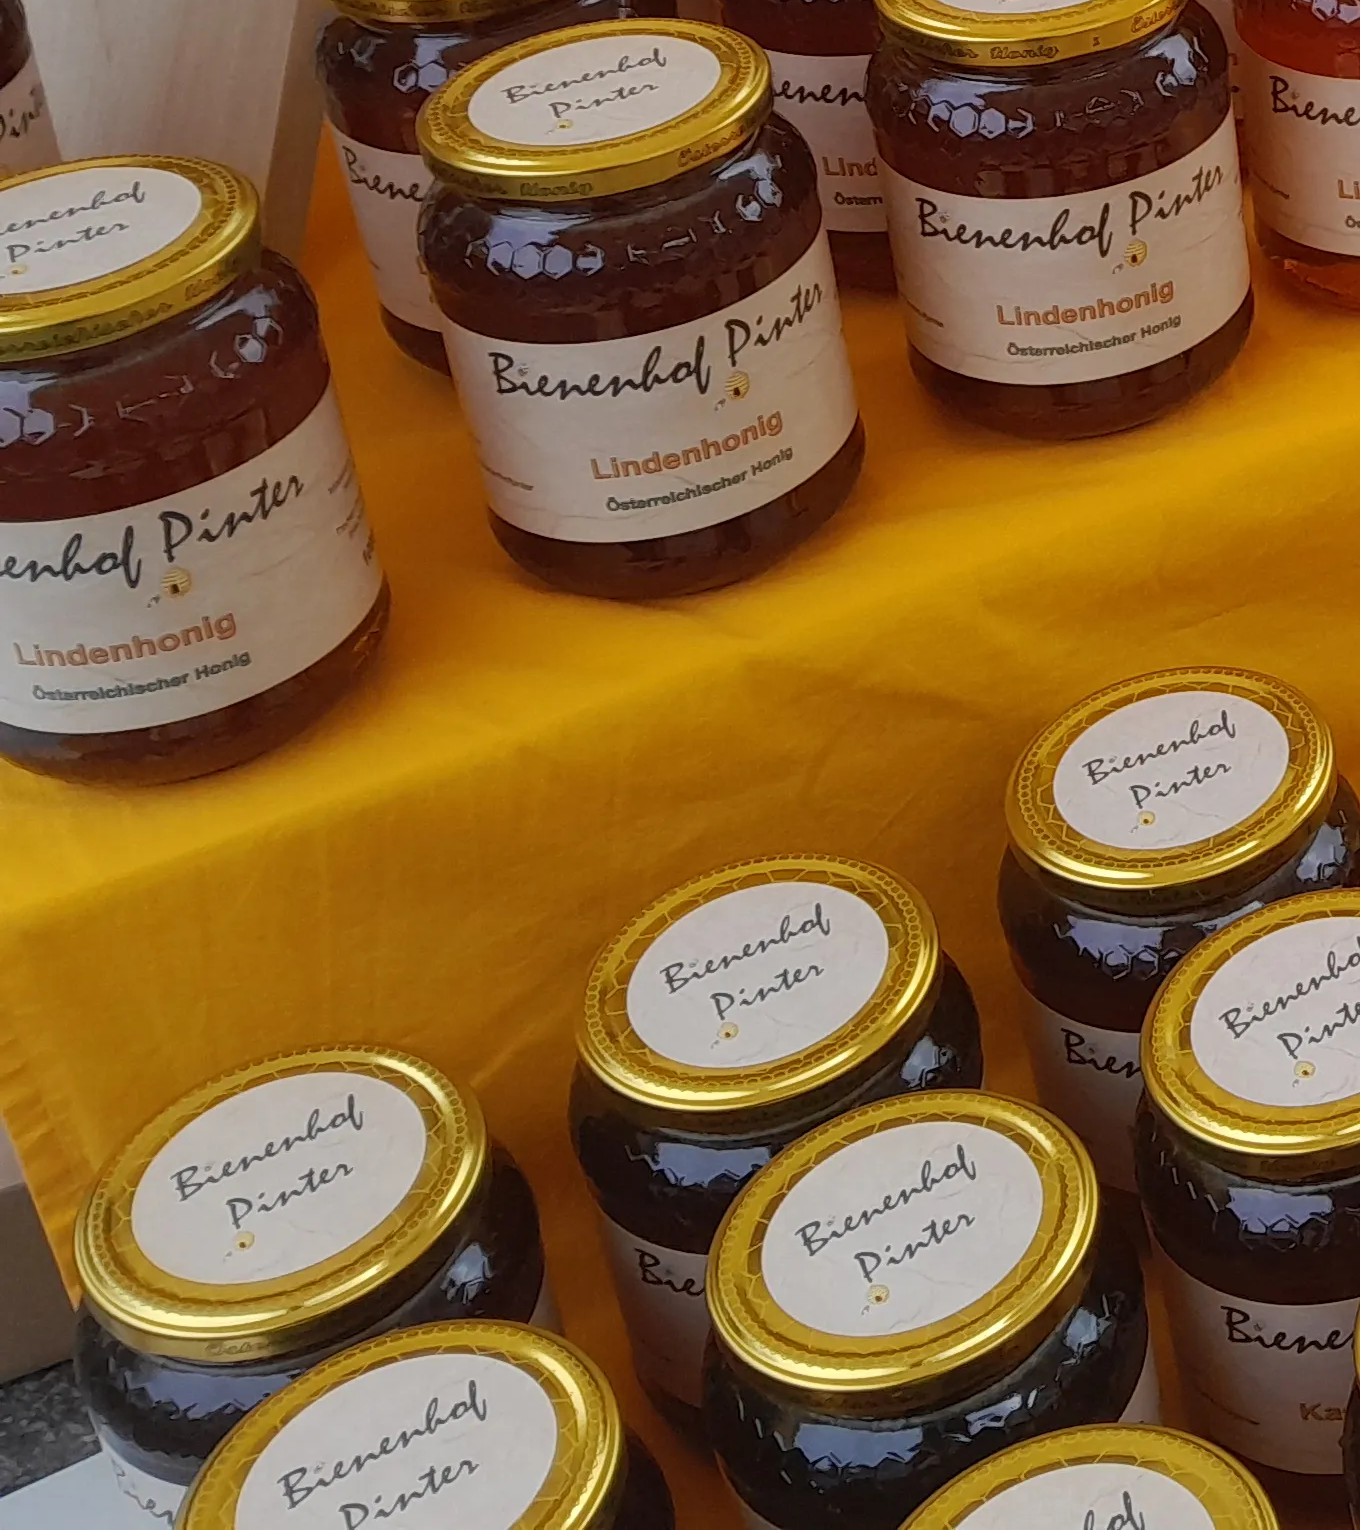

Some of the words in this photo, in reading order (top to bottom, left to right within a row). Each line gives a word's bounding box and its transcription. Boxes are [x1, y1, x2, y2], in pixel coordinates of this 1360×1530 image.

[500, 48, 668, 105] Bienenhof
[548, 82, 658, 119] Pinter
[6, 222, 129, 263] Pinter
[915, 197, 1112, 258] Bienenhof
[1129, 162, 1224, 236] Pinter
[996, 278, 1175, 327] Lindenhonig
[1006, 327, 1138, 358] Österreichischer
[1140, 313, 1183, 338] Honig
[488, 337, 712, 399] Bienenhof
[725, 281, 823, 368] Pinter
[591, 410, 783, 480] Lindenhonig
[606, 469, 748, 514] Österreichischer
[751, 444, 794, 477] Honig
[159, 474, 304, 563] Pinter
[13, 612, 237, 668] Lindenhonig
[32, 671, 190, 703] Österreichischer
[195, 651, 251, 681] Honig
[1082, 709, 1237, 785] Bienenhof
[1129, 762, 1232, 808] Pinter
[659, 903, 831, 994] Bienenhof
[710, 964, 824, 1020] Pinter
[170, 1094, 364, 1202] Bienenhof
[226, 1162, 354, 1230] Pinter
[795, 1144, 977, 1257] Bienenhof
[854, 1214, 975, 1282] Pinter
[277, 1380, 488, 1509] Bienenhof
[338, 1458, 479, 1530] Pinter
